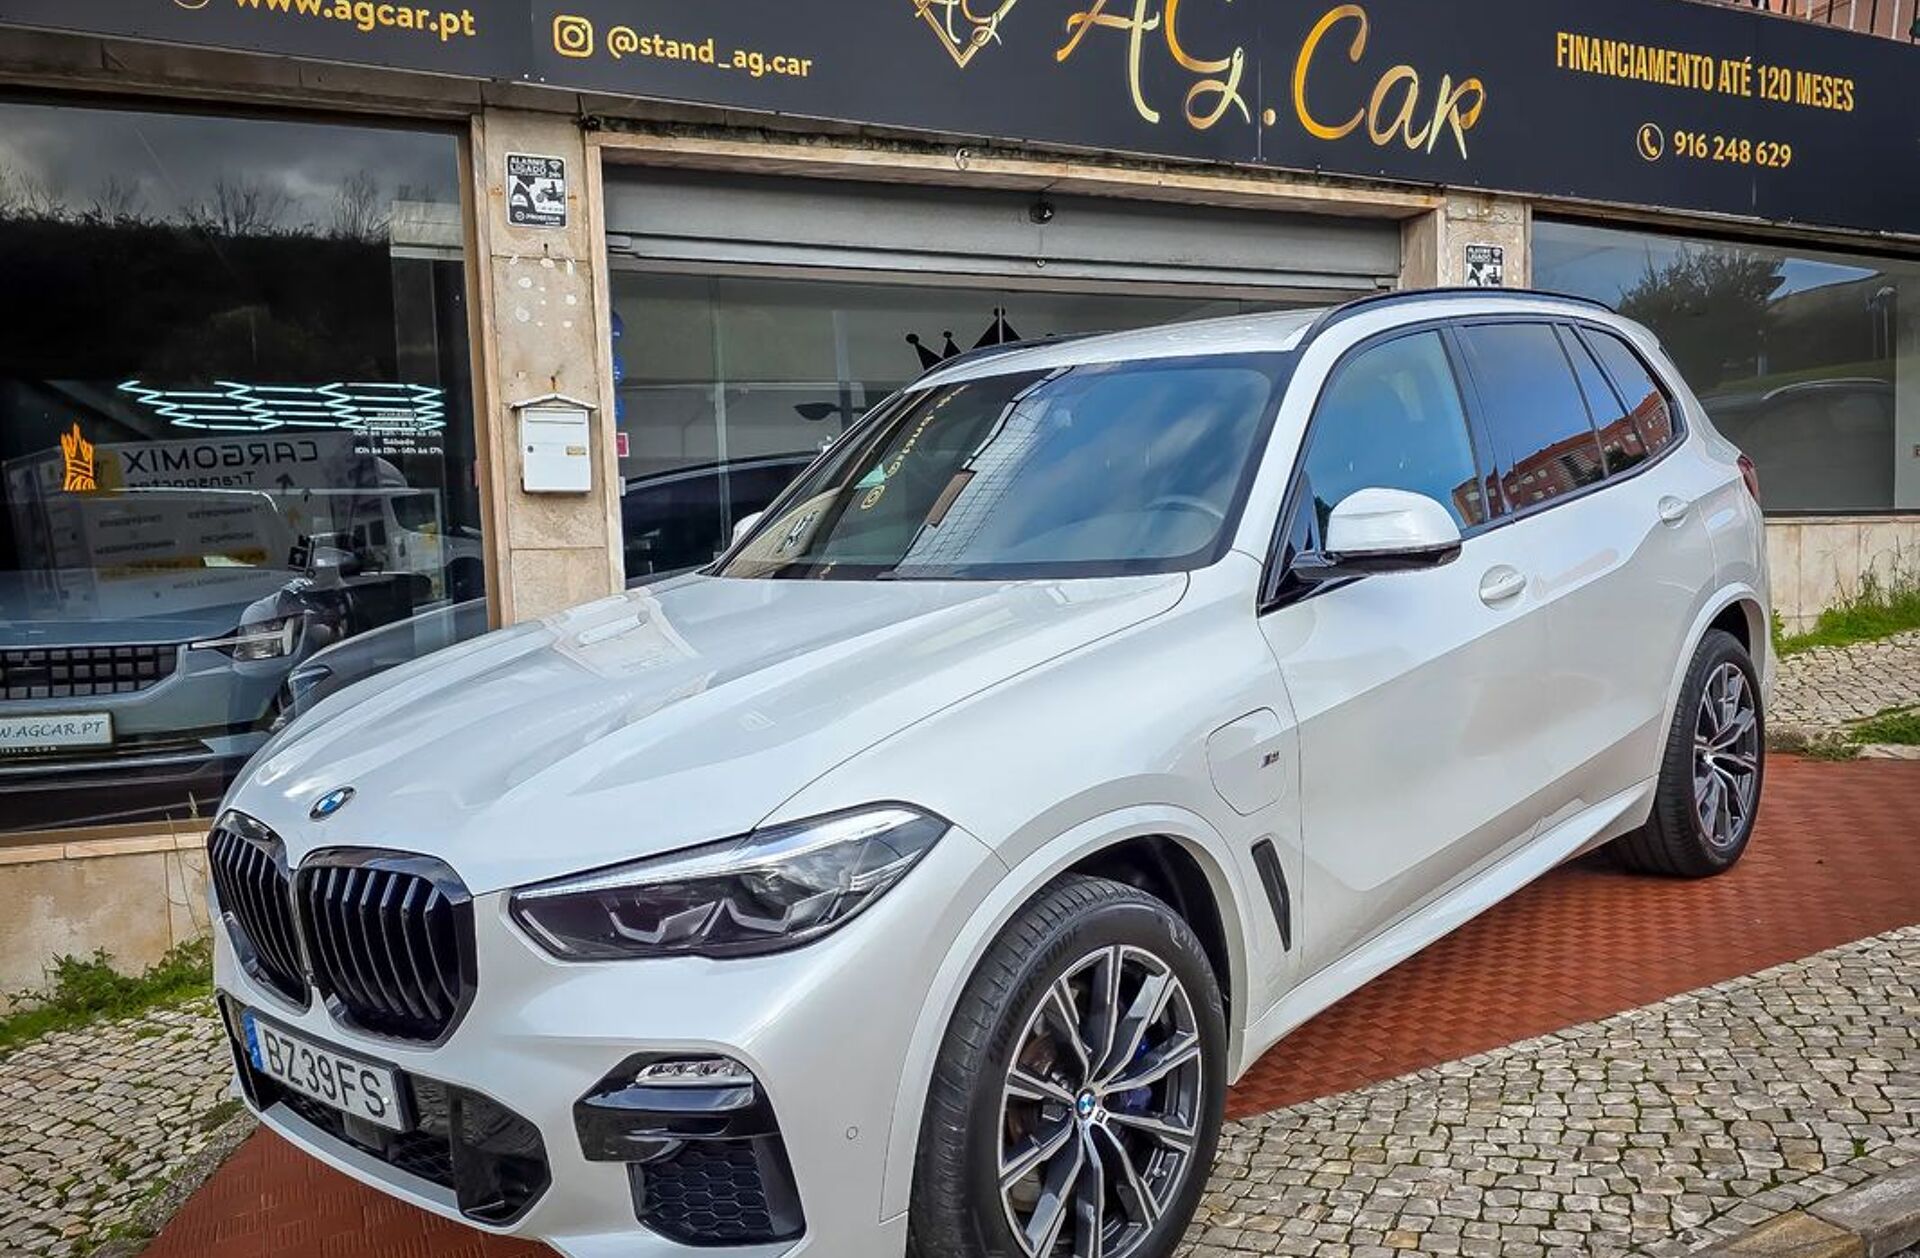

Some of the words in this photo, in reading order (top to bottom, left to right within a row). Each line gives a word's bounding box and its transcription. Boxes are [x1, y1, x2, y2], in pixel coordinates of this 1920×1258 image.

[606, 26, 812, 78] @stand_ag.car
[1556, 31, 1714, 91] FINANCIAMENTO
[1718, 56, 1752, 97] ATÉ
[1757, 64, 1792, 103] 120
[1796, 71, 1855, 113] MESES
[1674, 130, 1708, 159] 916
[1713, 135, 1750, 165] 248
[1755, 141, 1792, 169] 629
[264, 1030, 386, 1119] BZ39FS
